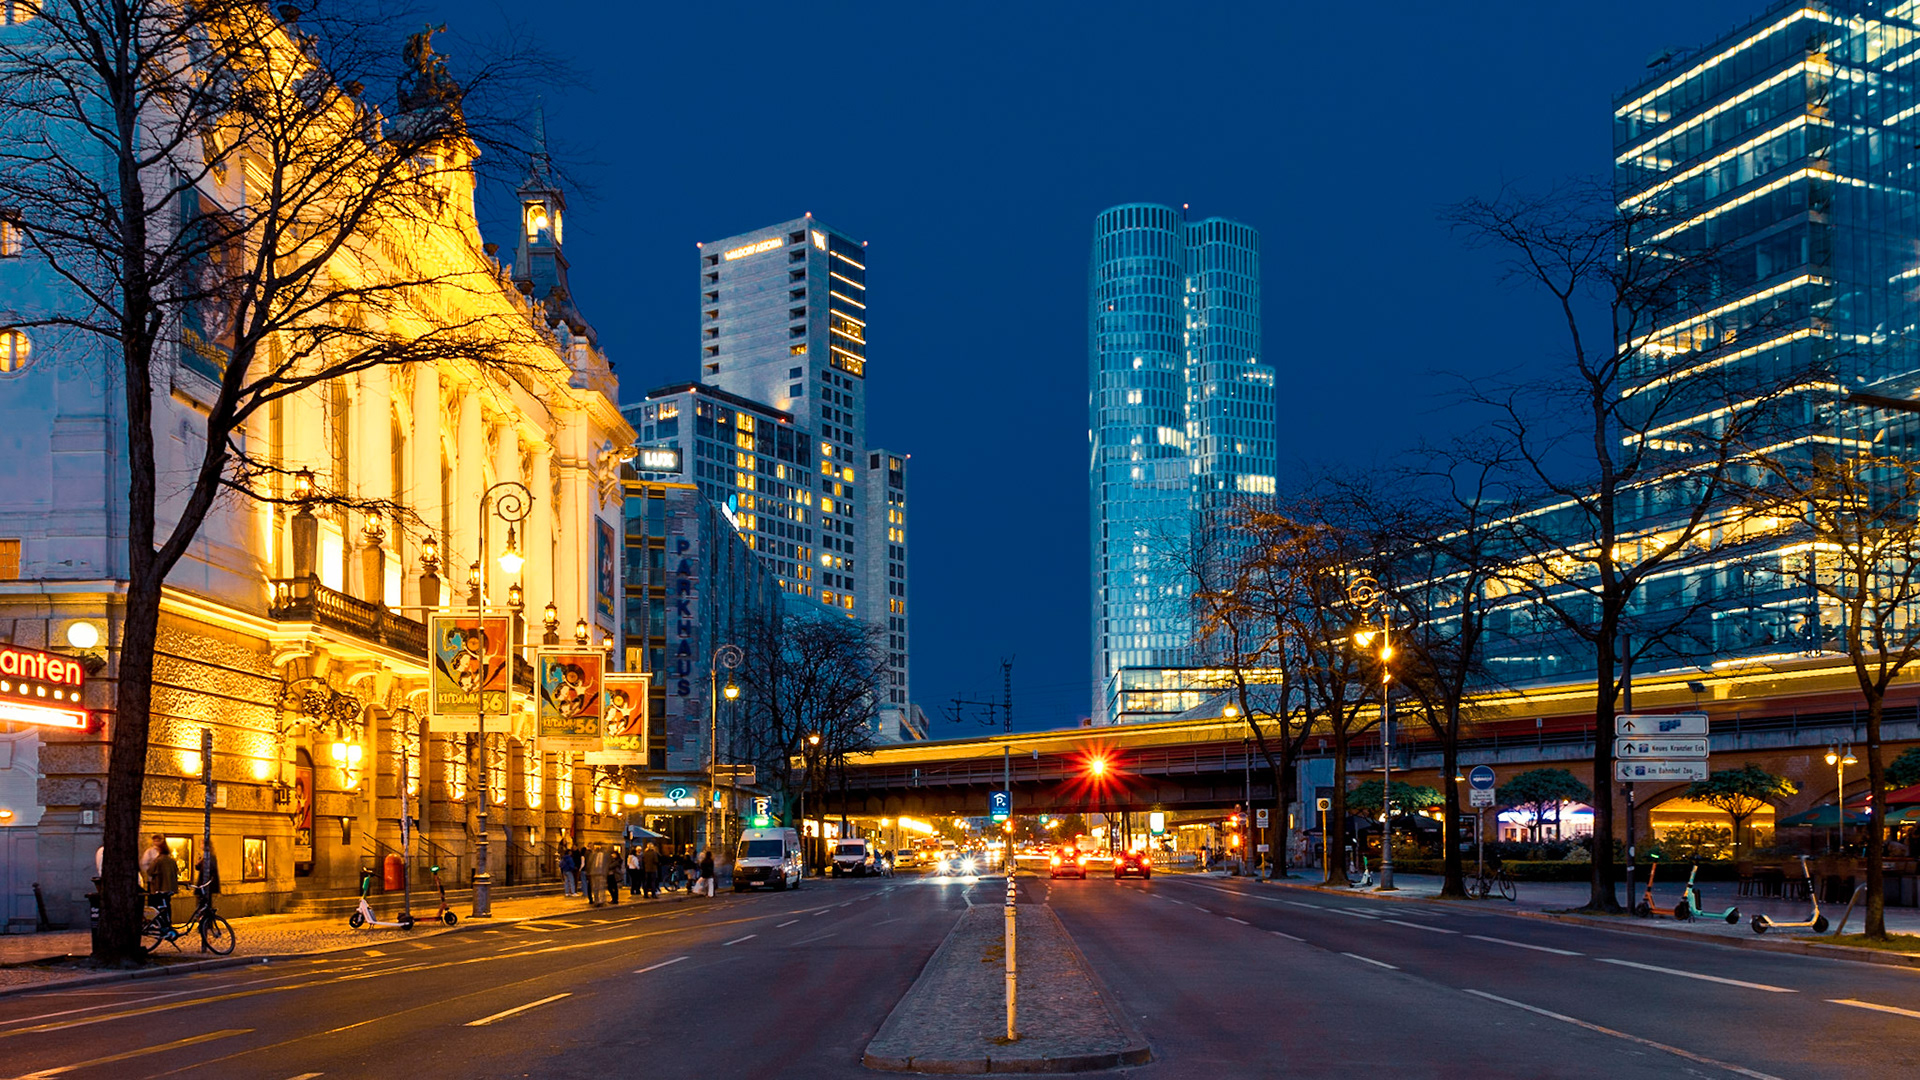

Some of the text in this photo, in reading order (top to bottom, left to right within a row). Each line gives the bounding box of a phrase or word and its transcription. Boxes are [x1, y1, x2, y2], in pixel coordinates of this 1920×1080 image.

[644, 451, 676, 468] LUX
[676, 539, 691, 697] PARKHAUS
[0, 650, 82, 685] anten
[574, 719, 597, 734] 56
[619, 736, 640, 750] 56
